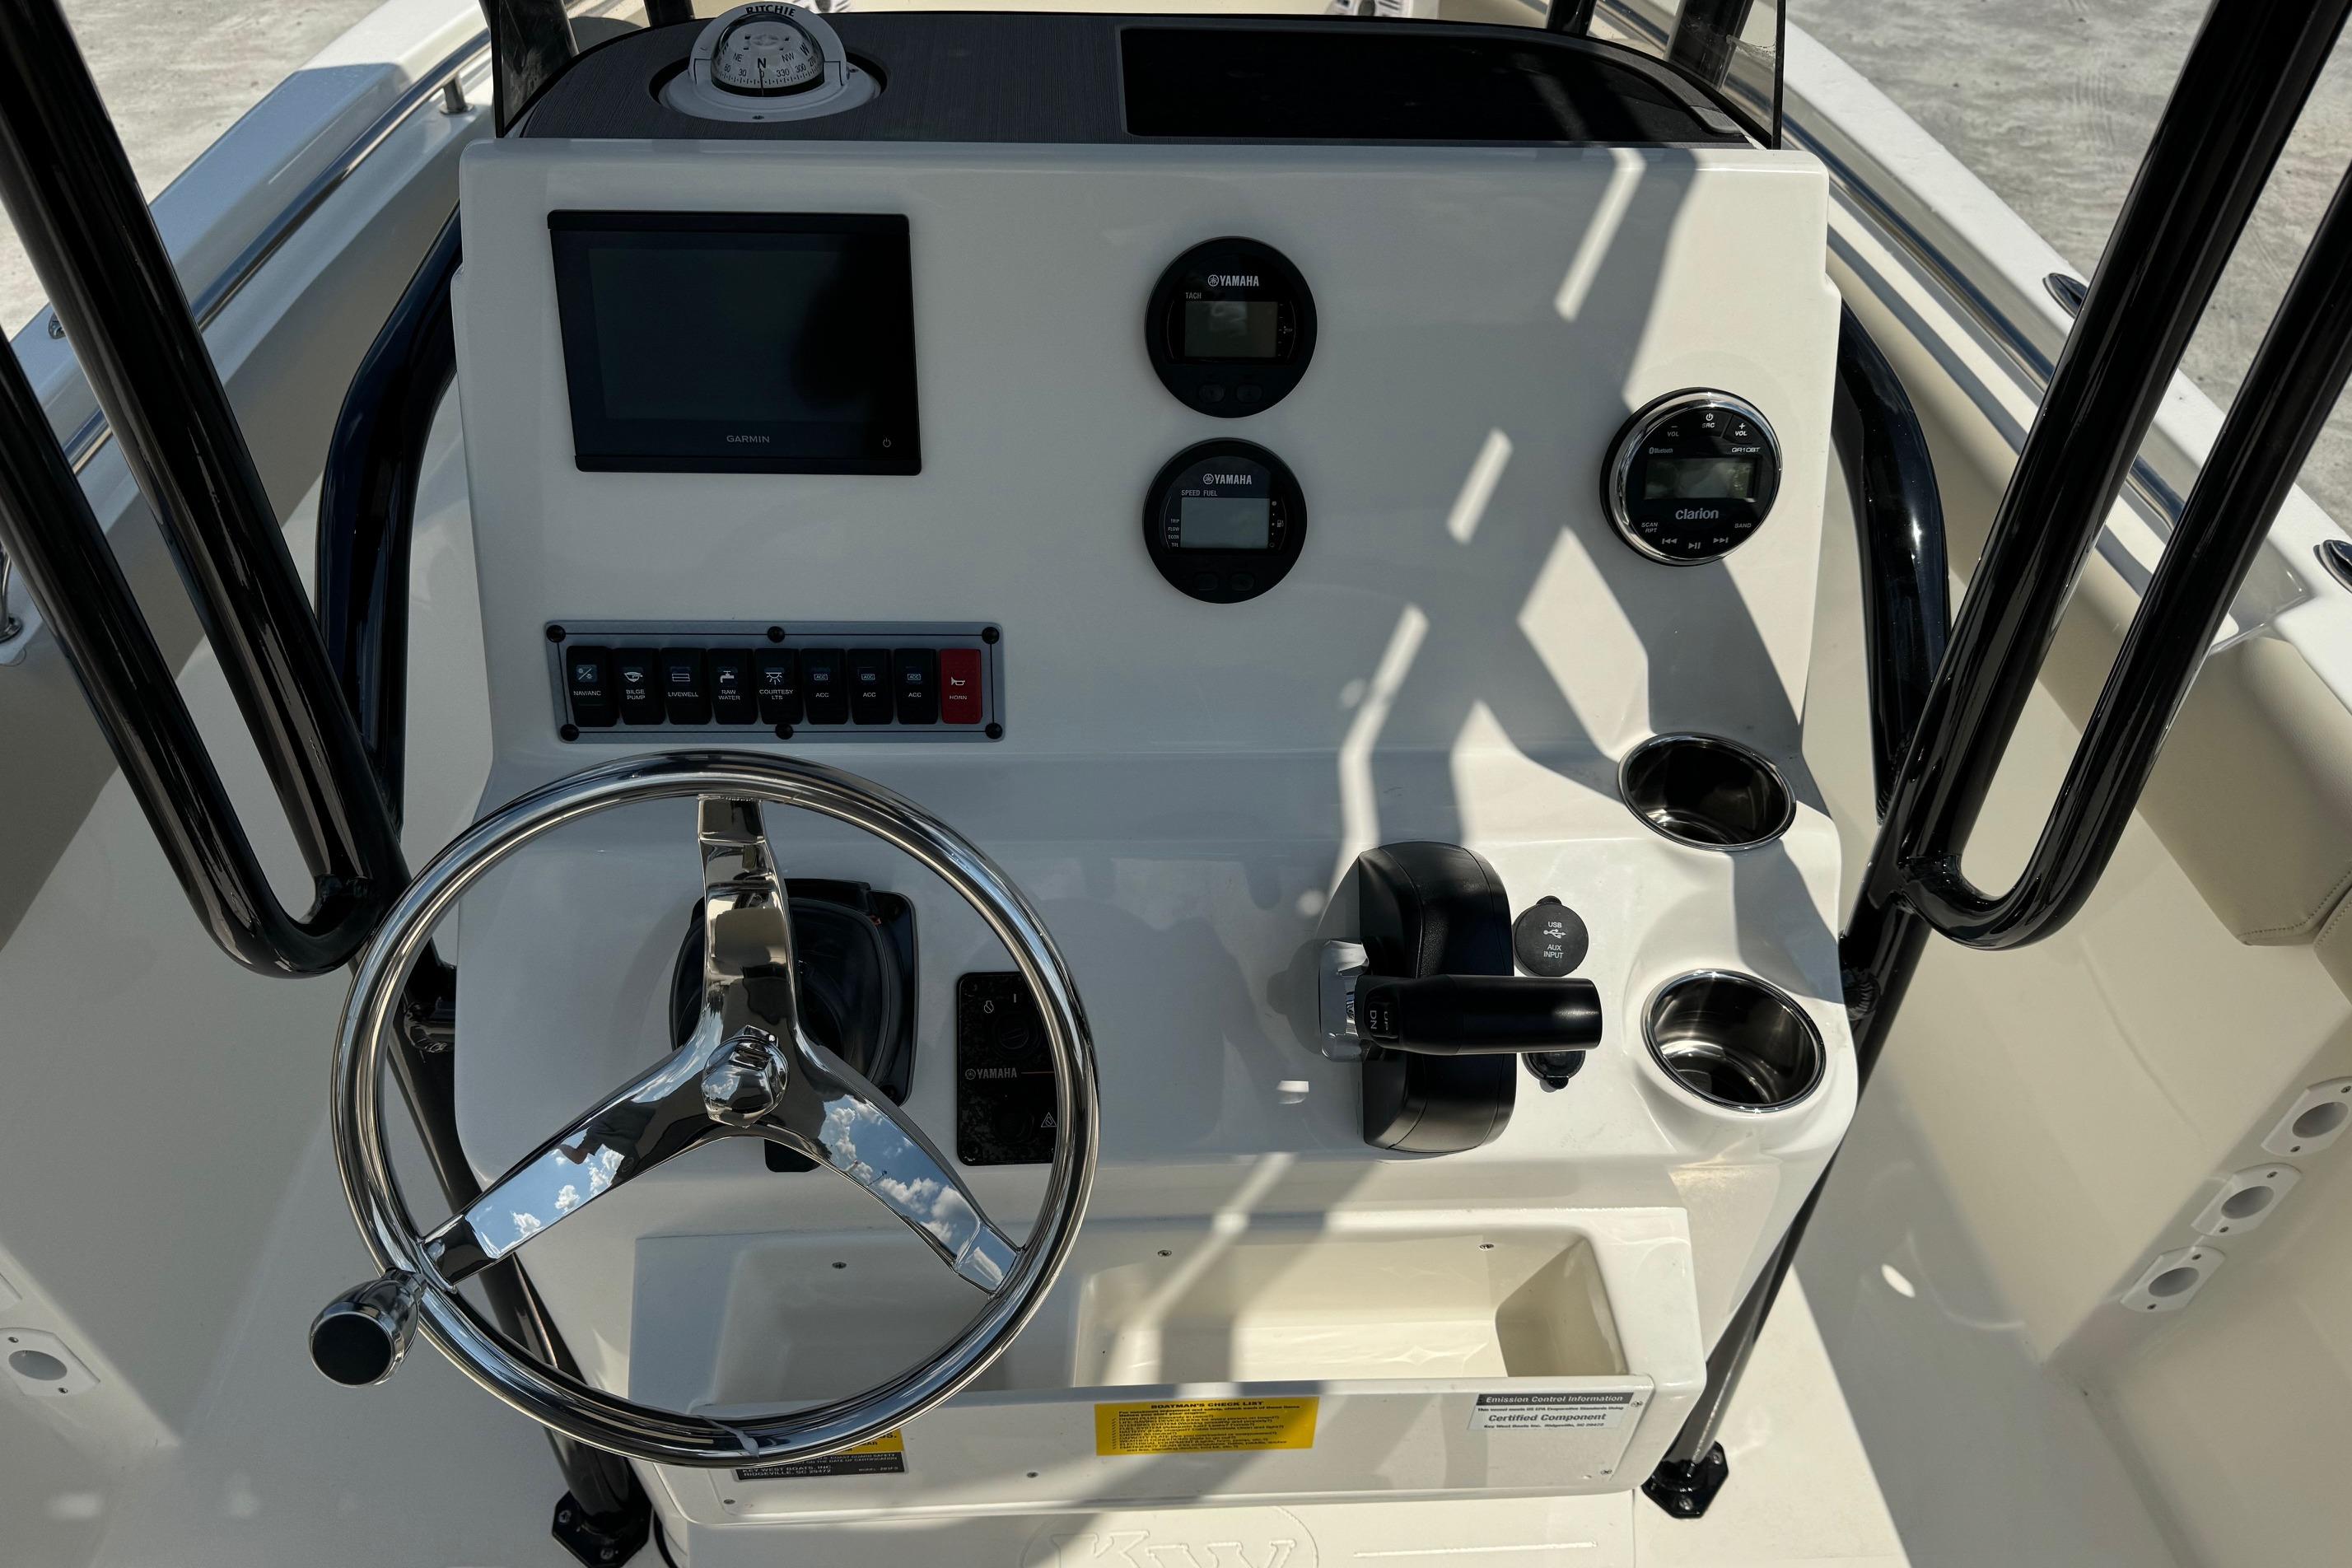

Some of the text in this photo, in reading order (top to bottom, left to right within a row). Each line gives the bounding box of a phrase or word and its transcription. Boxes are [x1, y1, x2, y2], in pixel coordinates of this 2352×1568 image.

[745, 4, 796, 17] RITCHIE
[733, 52, 795, 68] NE N NW
[738, 68, 747, 77] 30
[776, 68, 790, 77] 330
[795, 63, 807, 72] 300
[1220, 276, 1259, 287] YAMAHA
[1215, 474, 1252, 485] YAMAHA
[1675, 508, 1720, 520] clarion
[1543, 951, 1564, 959] INPUT
[1370, 1010, 1377, 1029] DN
[977, 1067, 1017, 1079] YAMAHA
[1489, 1414, 1607, 1422] Certified Component
